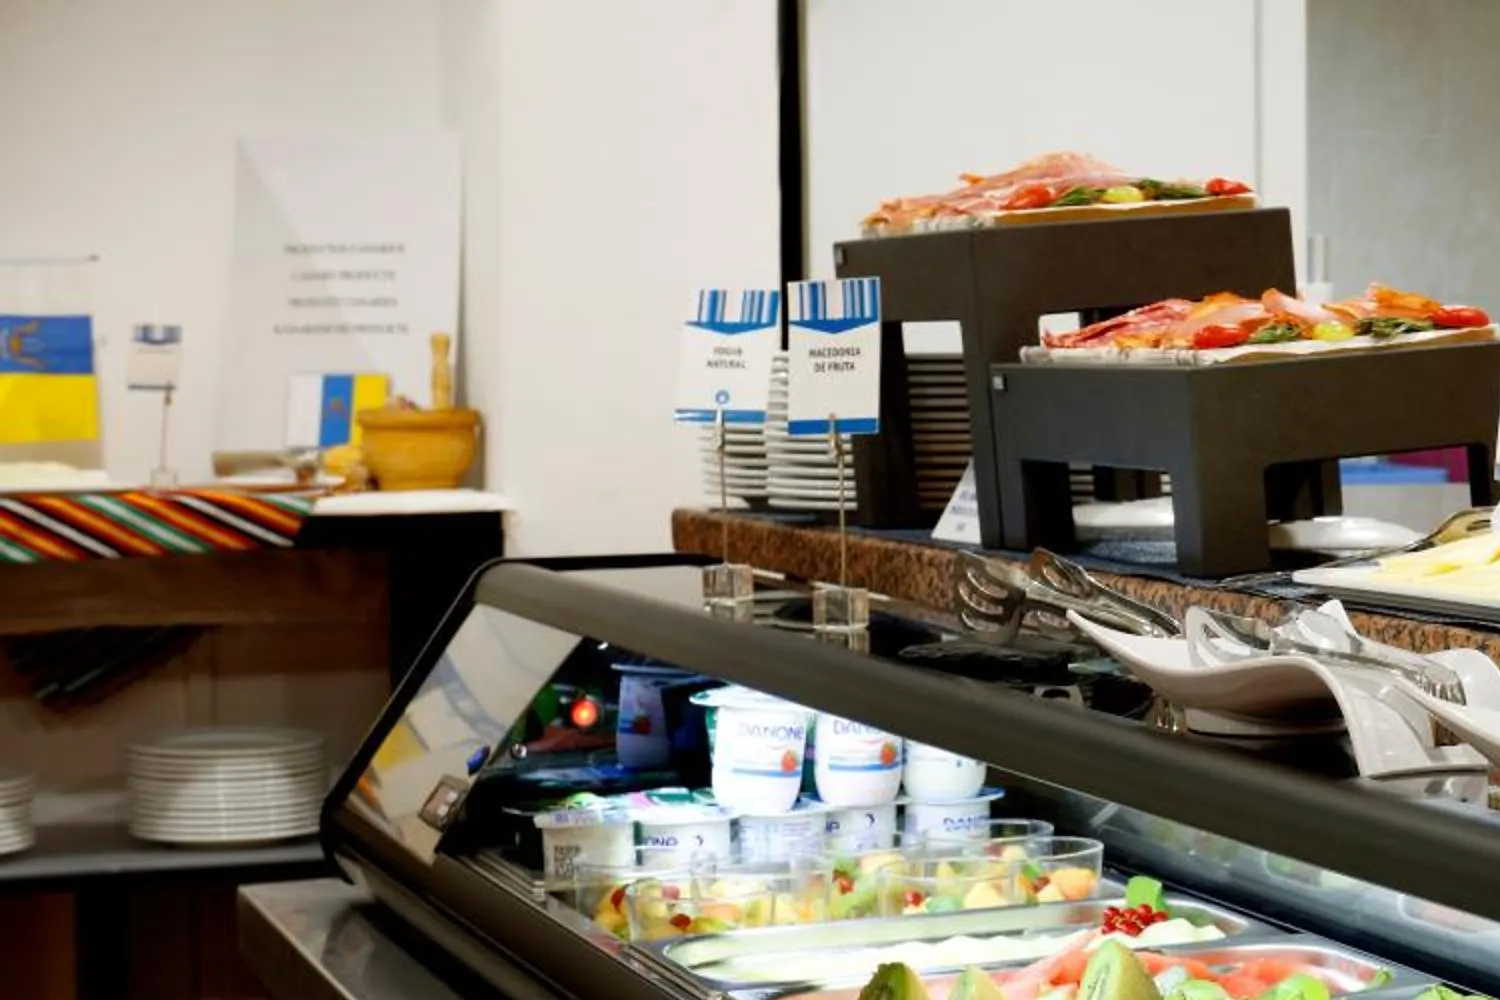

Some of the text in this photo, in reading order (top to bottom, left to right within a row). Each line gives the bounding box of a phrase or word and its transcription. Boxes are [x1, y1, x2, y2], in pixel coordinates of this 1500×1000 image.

[809, 347, 861, 358] MACEDONIA
[706, 359, 746, 369] NATURAL
[814, 361, 856, 373] DE FRUTA
